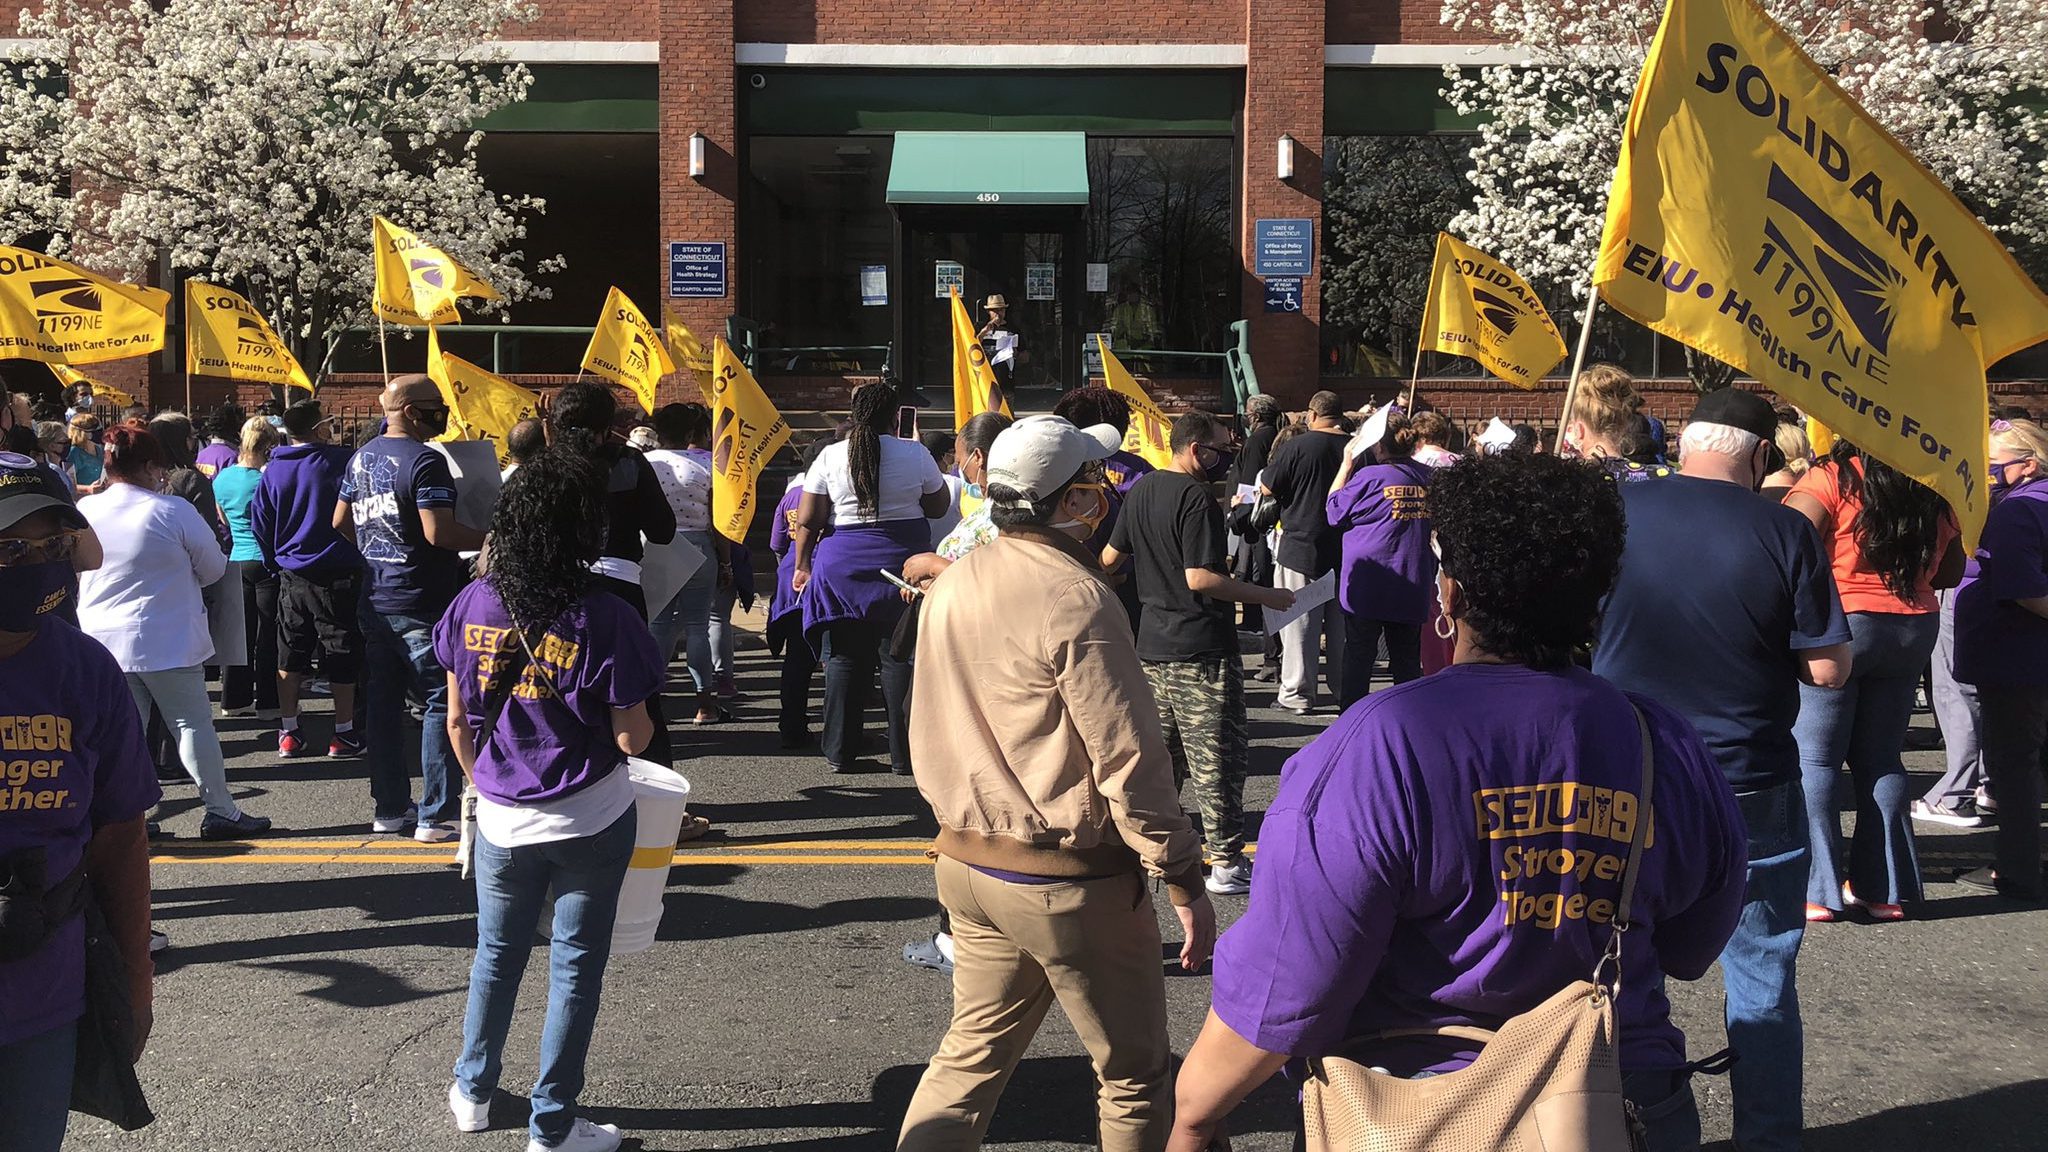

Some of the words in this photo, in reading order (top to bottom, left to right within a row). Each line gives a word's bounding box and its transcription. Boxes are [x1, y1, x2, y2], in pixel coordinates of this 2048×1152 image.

[976, 192, 1000, 202] 450
[1696, 42, 1979, 329] SOLIDARITY
[1454, 258, 1559, 338] SOLIDARITY
[1753, 242, 1892, 386] 1199NE
[38, 314, 103, 334] 1199NE
[37, 341, 81, 353] Health
[84, 339, 106, 351] Care
[108, 337, 128, 348] For
[1440, 331, 1468, 343] SEIU
[1496, 357, 1512, 370] For
[1622, 239, 1699, 294] EIU
[1719, 288, 1812, 381] Health
[1821, 368, 1892, 429] Care
[1900, 413, 1952, 463] For
[199, 357, 225, 368] SEIU
[231, 360, 265, 373] Health
[592, 357, 614, 371] SEIU
[617, 367, 641, 384] Health
